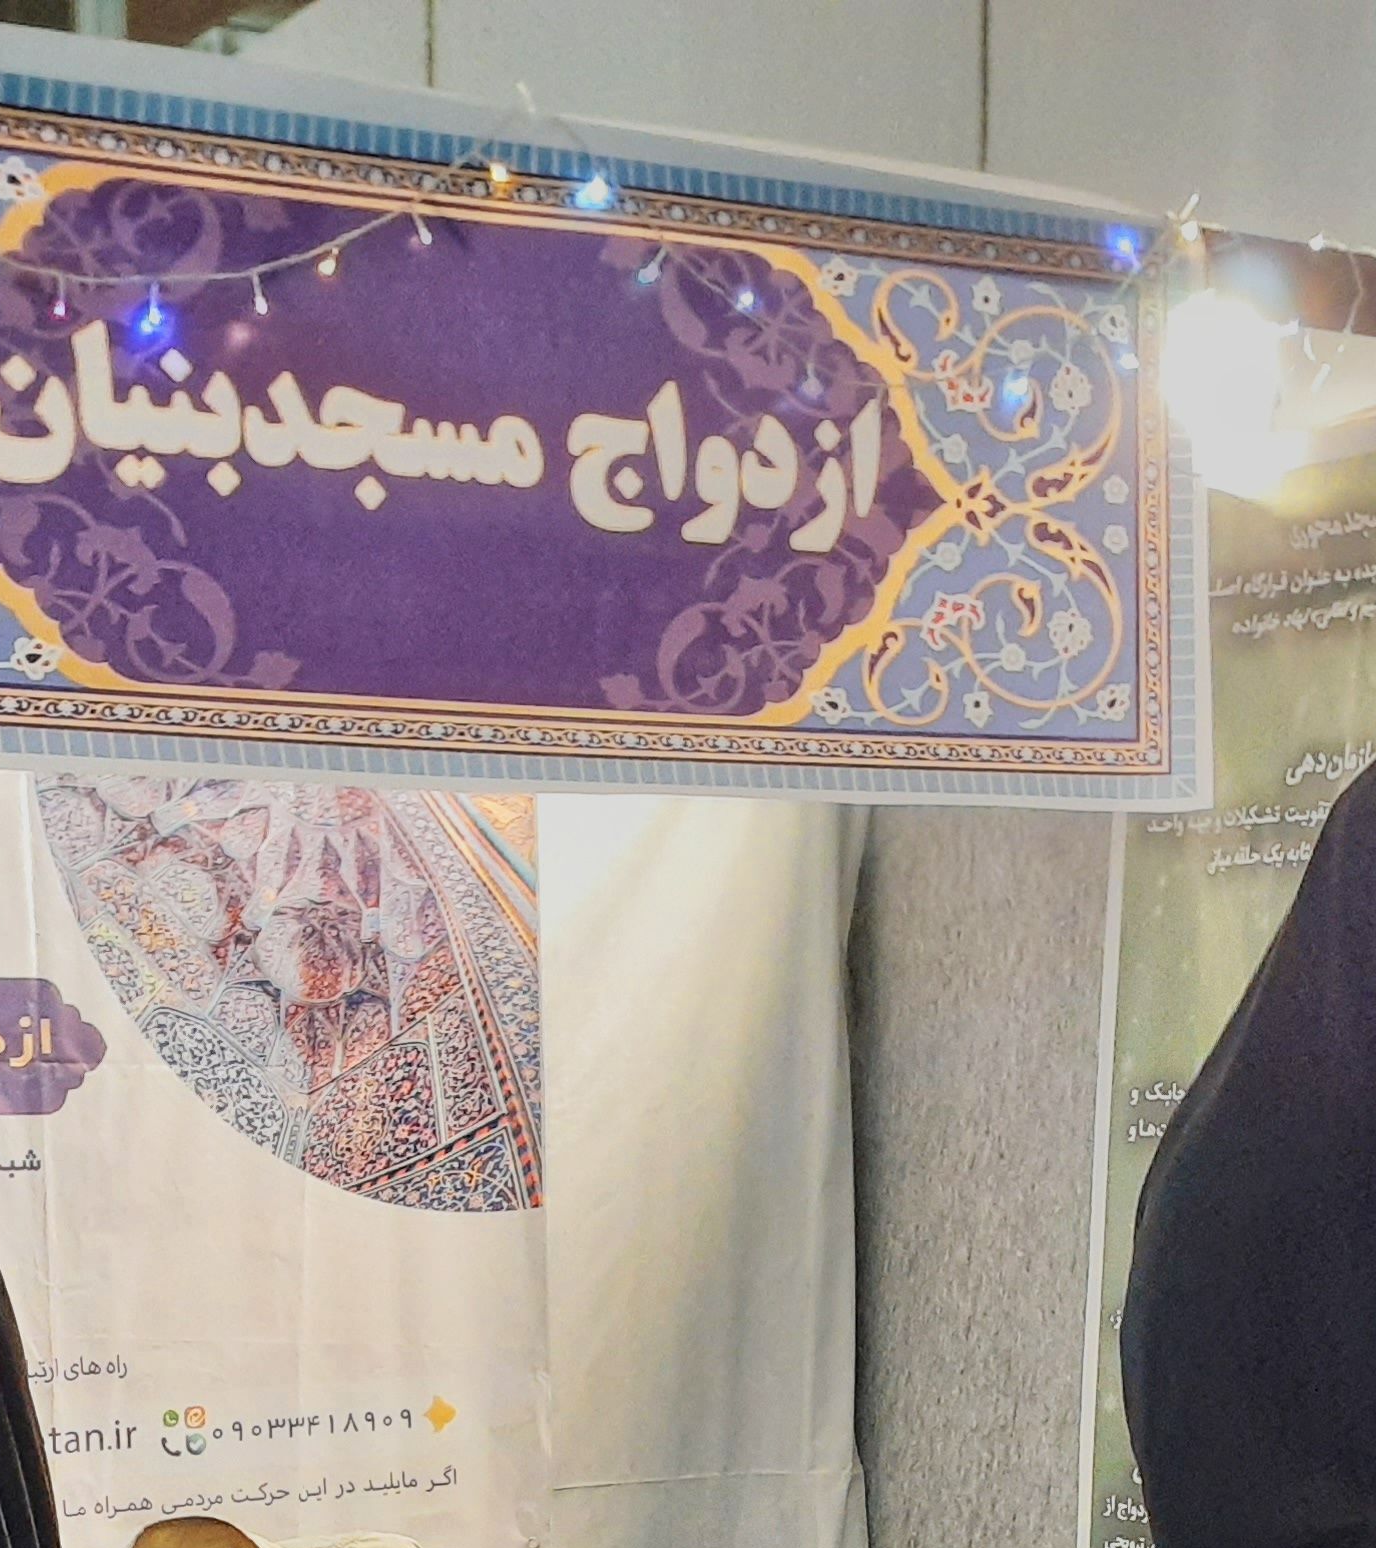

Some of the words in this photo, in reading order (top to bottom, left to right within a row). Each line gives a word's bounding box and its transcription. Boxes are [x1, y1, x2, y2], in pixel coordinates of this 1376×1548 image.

[566, 381, 881, 552] ازدواج
[27, 1357, 59, 1384] ارتب
[63, 1356, 102, 1381] های
[106, 1354, 128, 1379] راه
[48, 1419, 137, 1454] tan.ir
[298, 1477, 328, 1502] این
[335, 1480, 356, 1499] در
[363, 1471, 418, 1496] مایلید
[425, 1465, 457, 1492] اگر
[161, 1494, 224, 1515] مردمی
[230, 1480, 291, 1506] حرکت
[62, 1499, 87, 1518] ما
[94, 1495, 154, 1520] همراه
